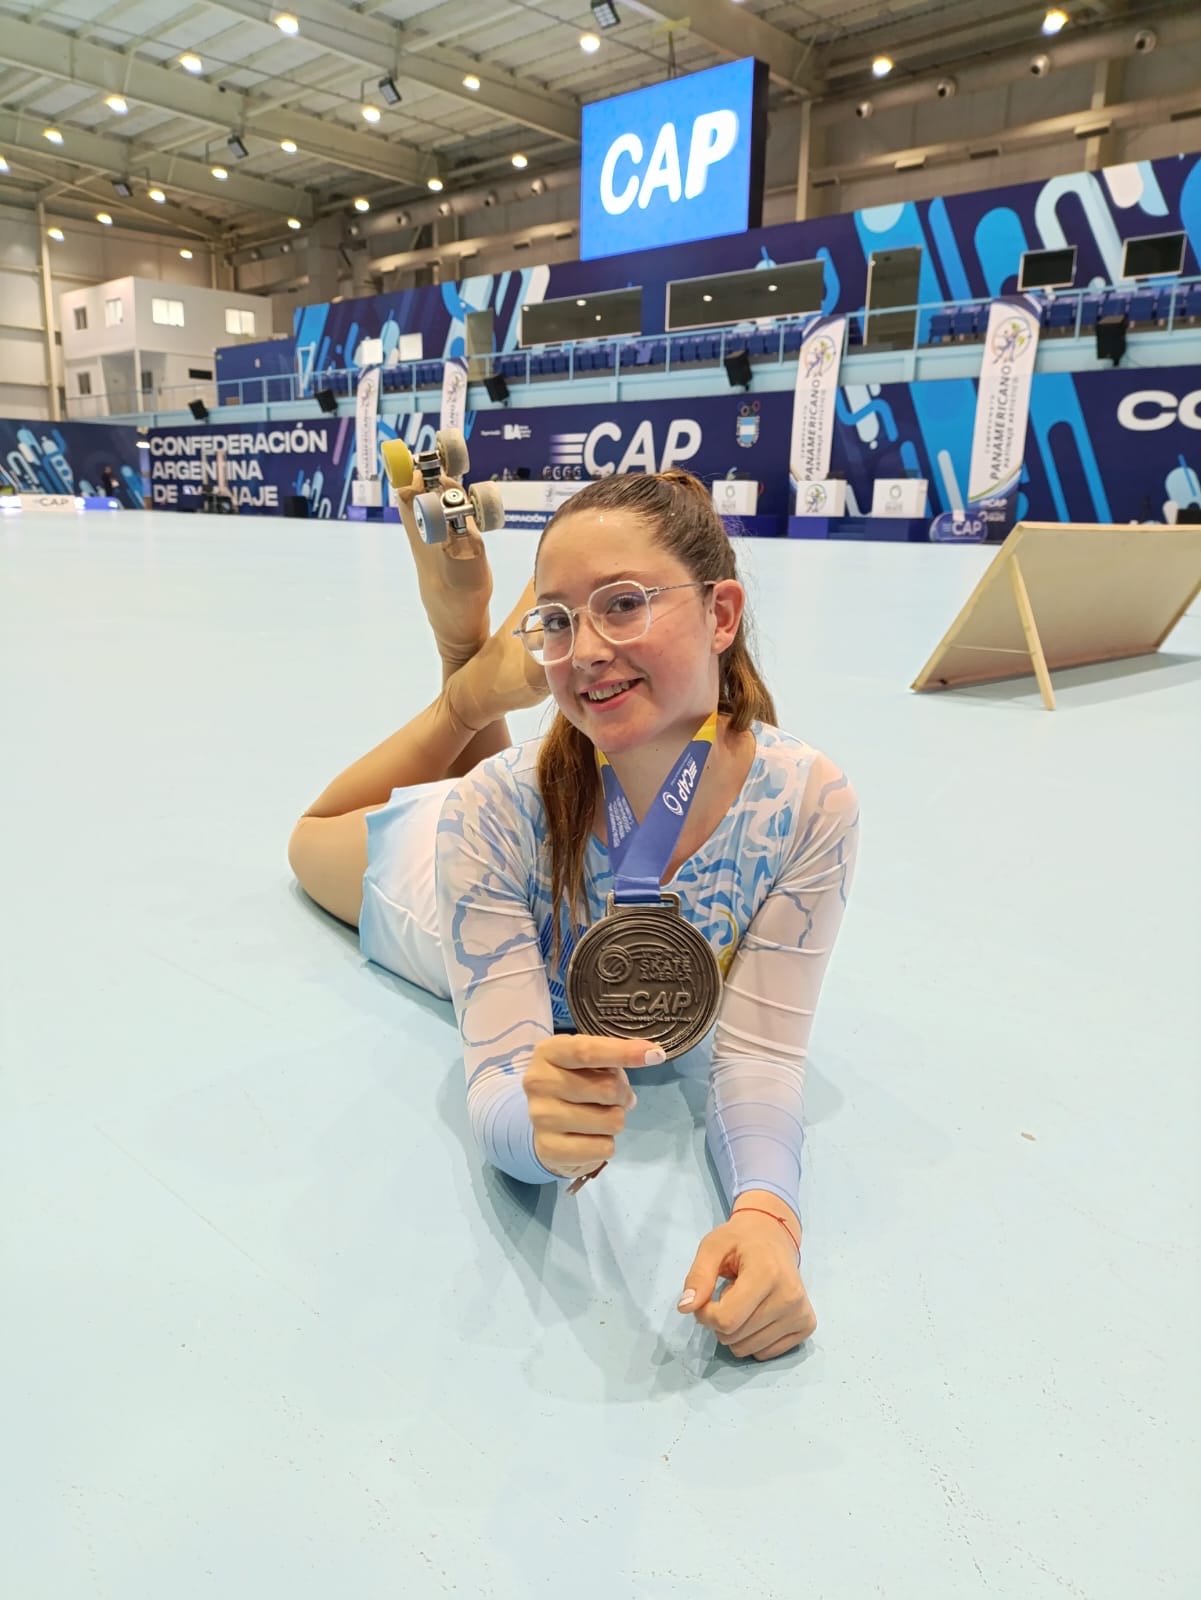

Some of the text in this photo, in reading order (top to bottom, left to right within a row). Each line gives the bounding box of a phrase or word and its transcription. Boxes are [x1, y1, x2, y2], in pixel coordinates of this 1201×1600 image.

[600, 109, 740, 216] CAP
[151, 422, 328, 456] CONFEDERACIÓN
[805, 379, 820, 481] PANAMERICANO
[990, 365, 1012, 480] PANAMERICANO
[584, 419, 702, 477] CAP
[152, 460, 264, 481] ARGENINA
[153, 485, 179, 503] DE
[951, 520, 982, 536] CAP
[677, 768, 695, 802] CAP
[629, 990, 692, 1014] CAP
